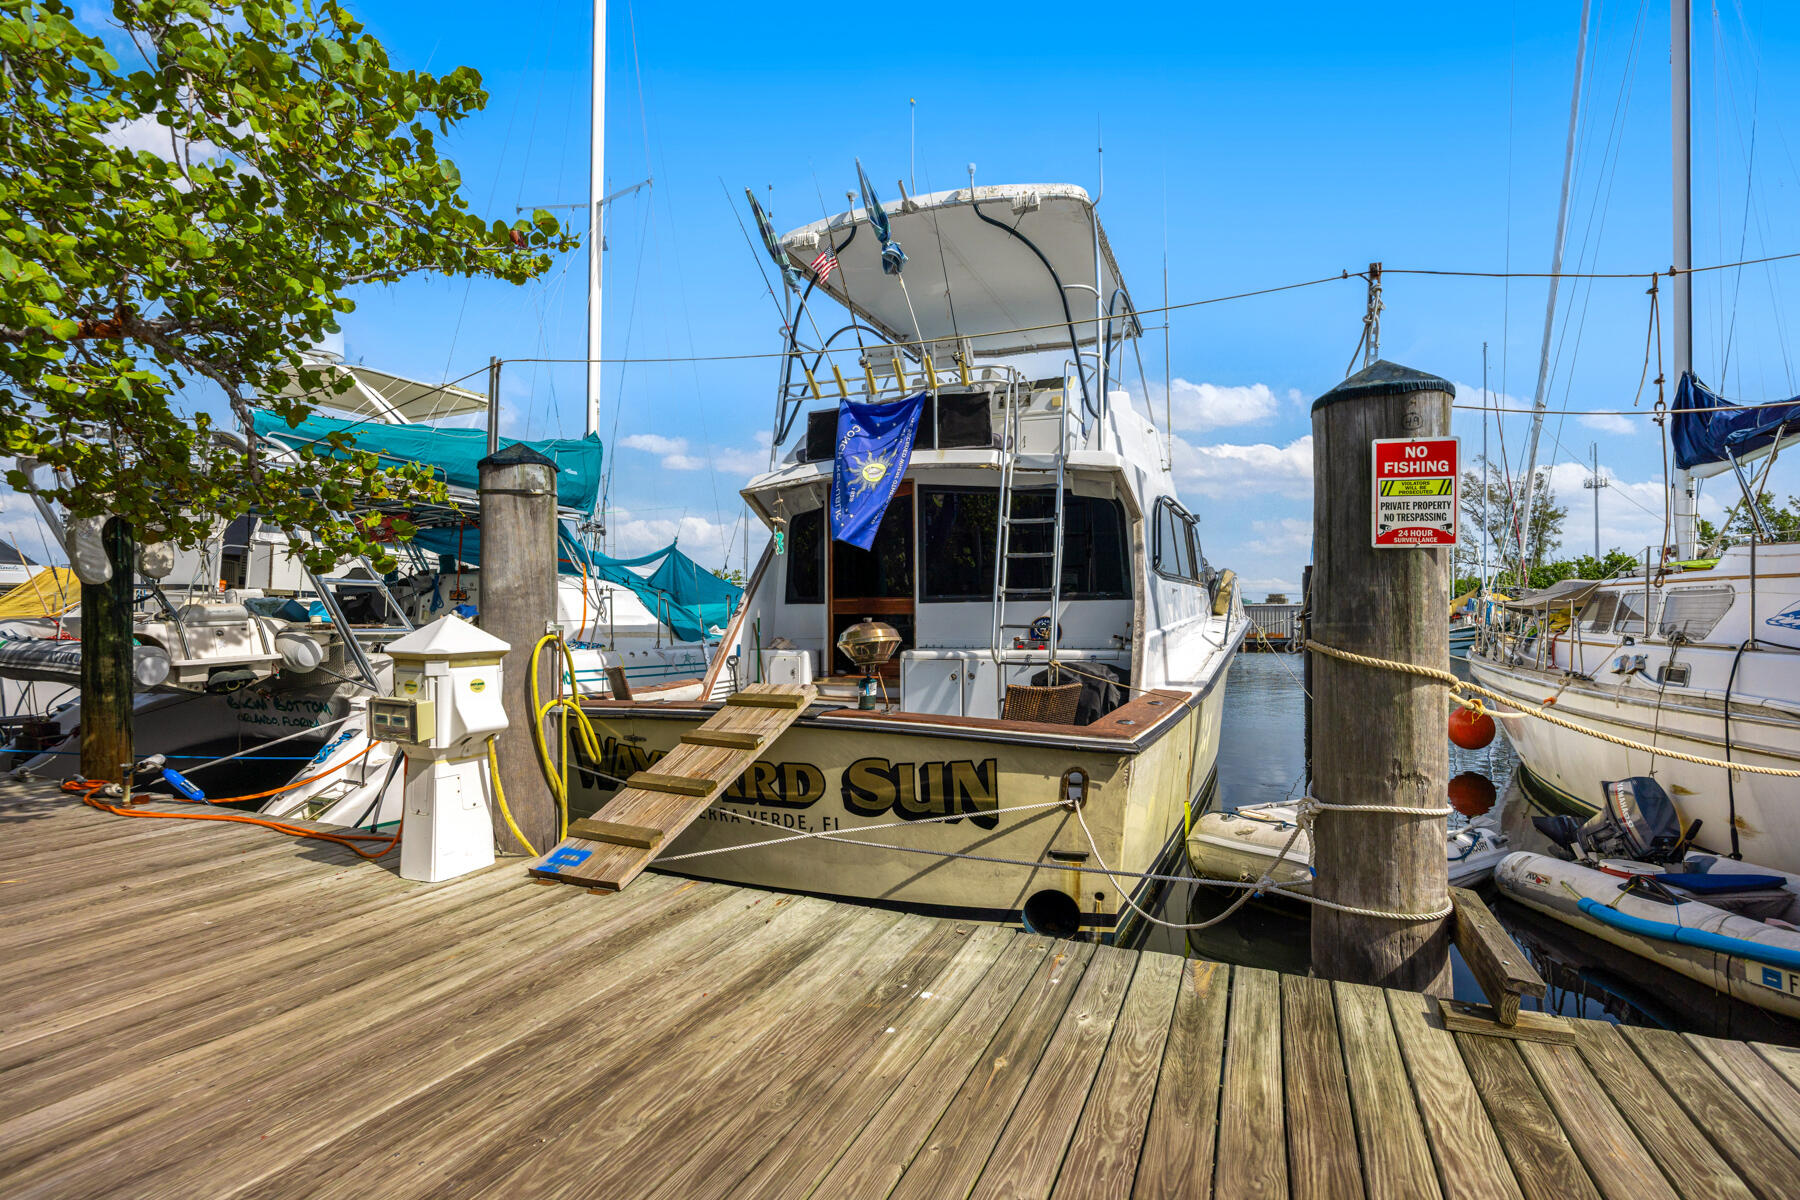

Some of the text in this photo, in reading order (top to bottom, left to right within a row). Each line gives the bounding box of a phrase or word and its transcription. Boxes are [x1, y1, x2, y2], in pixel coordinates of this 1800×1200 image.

[1405, 446, 1428, 458] NO
[1384, 460, 1449, 473] FISHING
[1380, 501, 1452, 511] PRIVATE PROPERTY
[1384, 512, 1447, 522] NO TRESPASSING
[1410, 529, 1433, 537] HOUR
[273, 695, 333, 716] BOTTOM
[747, 810, 814, 833] VERDE,
